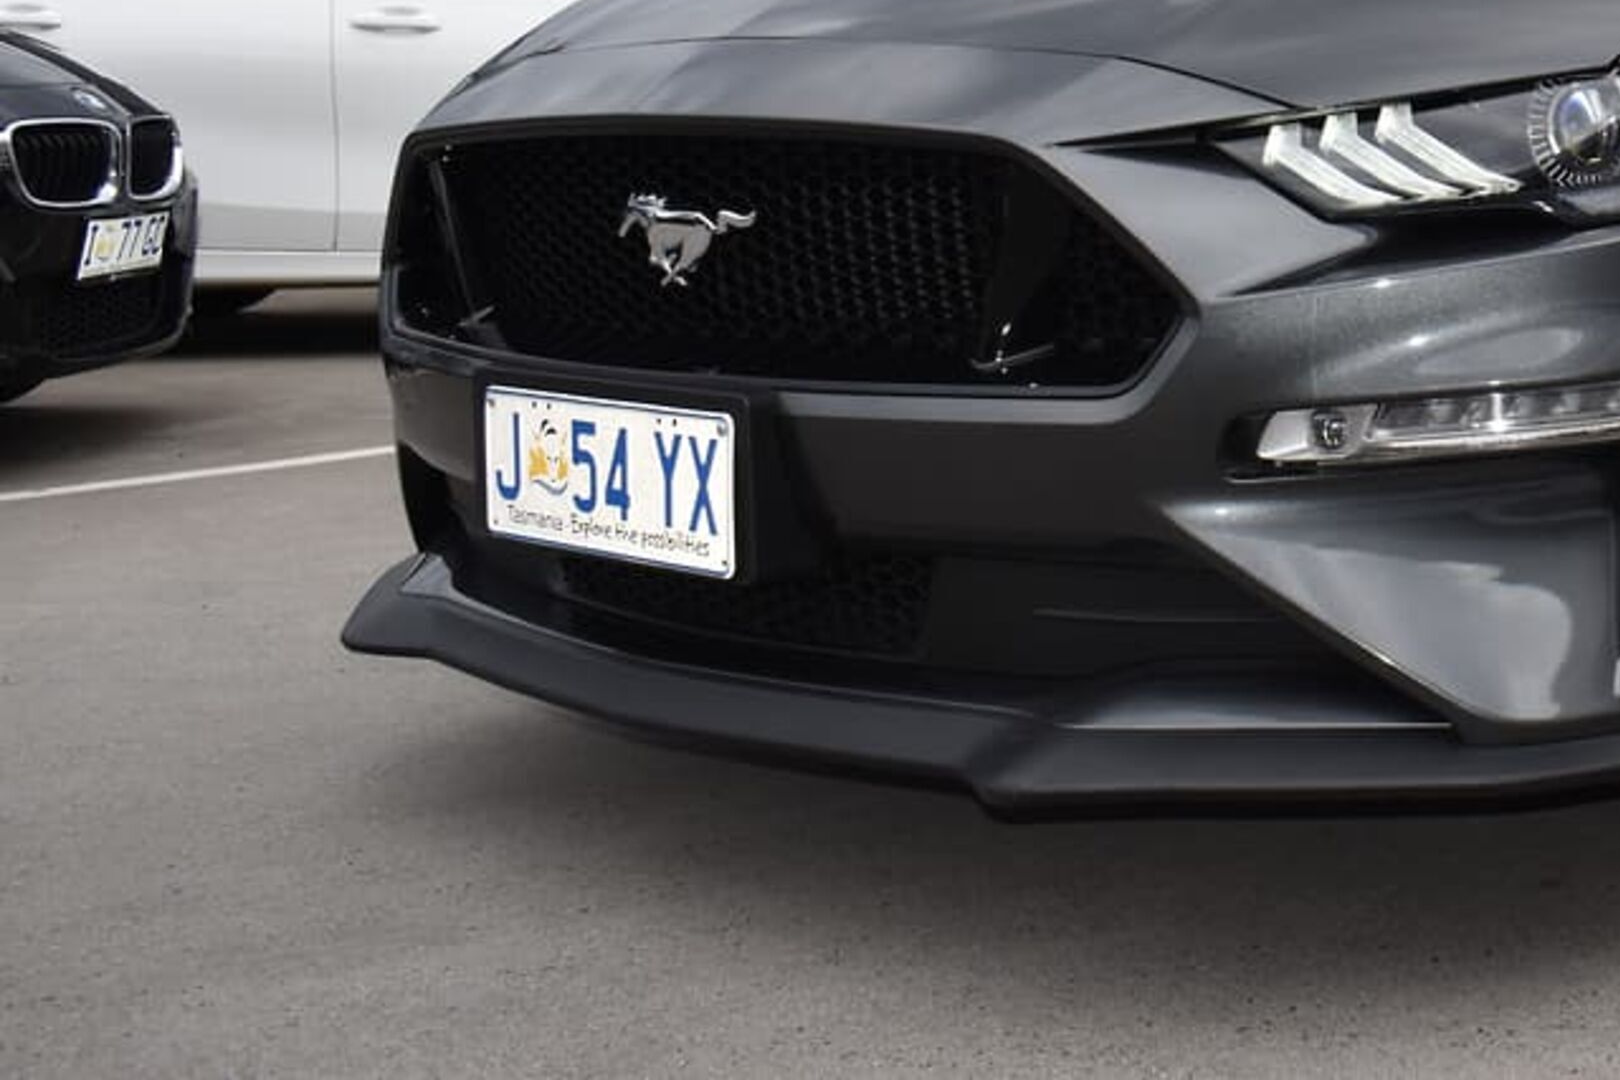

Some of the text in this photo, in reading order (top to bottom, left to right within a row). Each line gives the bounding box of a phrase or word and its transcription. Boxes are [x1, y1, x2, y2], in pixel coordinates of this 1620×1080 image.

[495, 412, 718, 536] J 54 YX
[507, 505, 563, 531] Tasmania
[641, 532, 710, 557] possibilities
